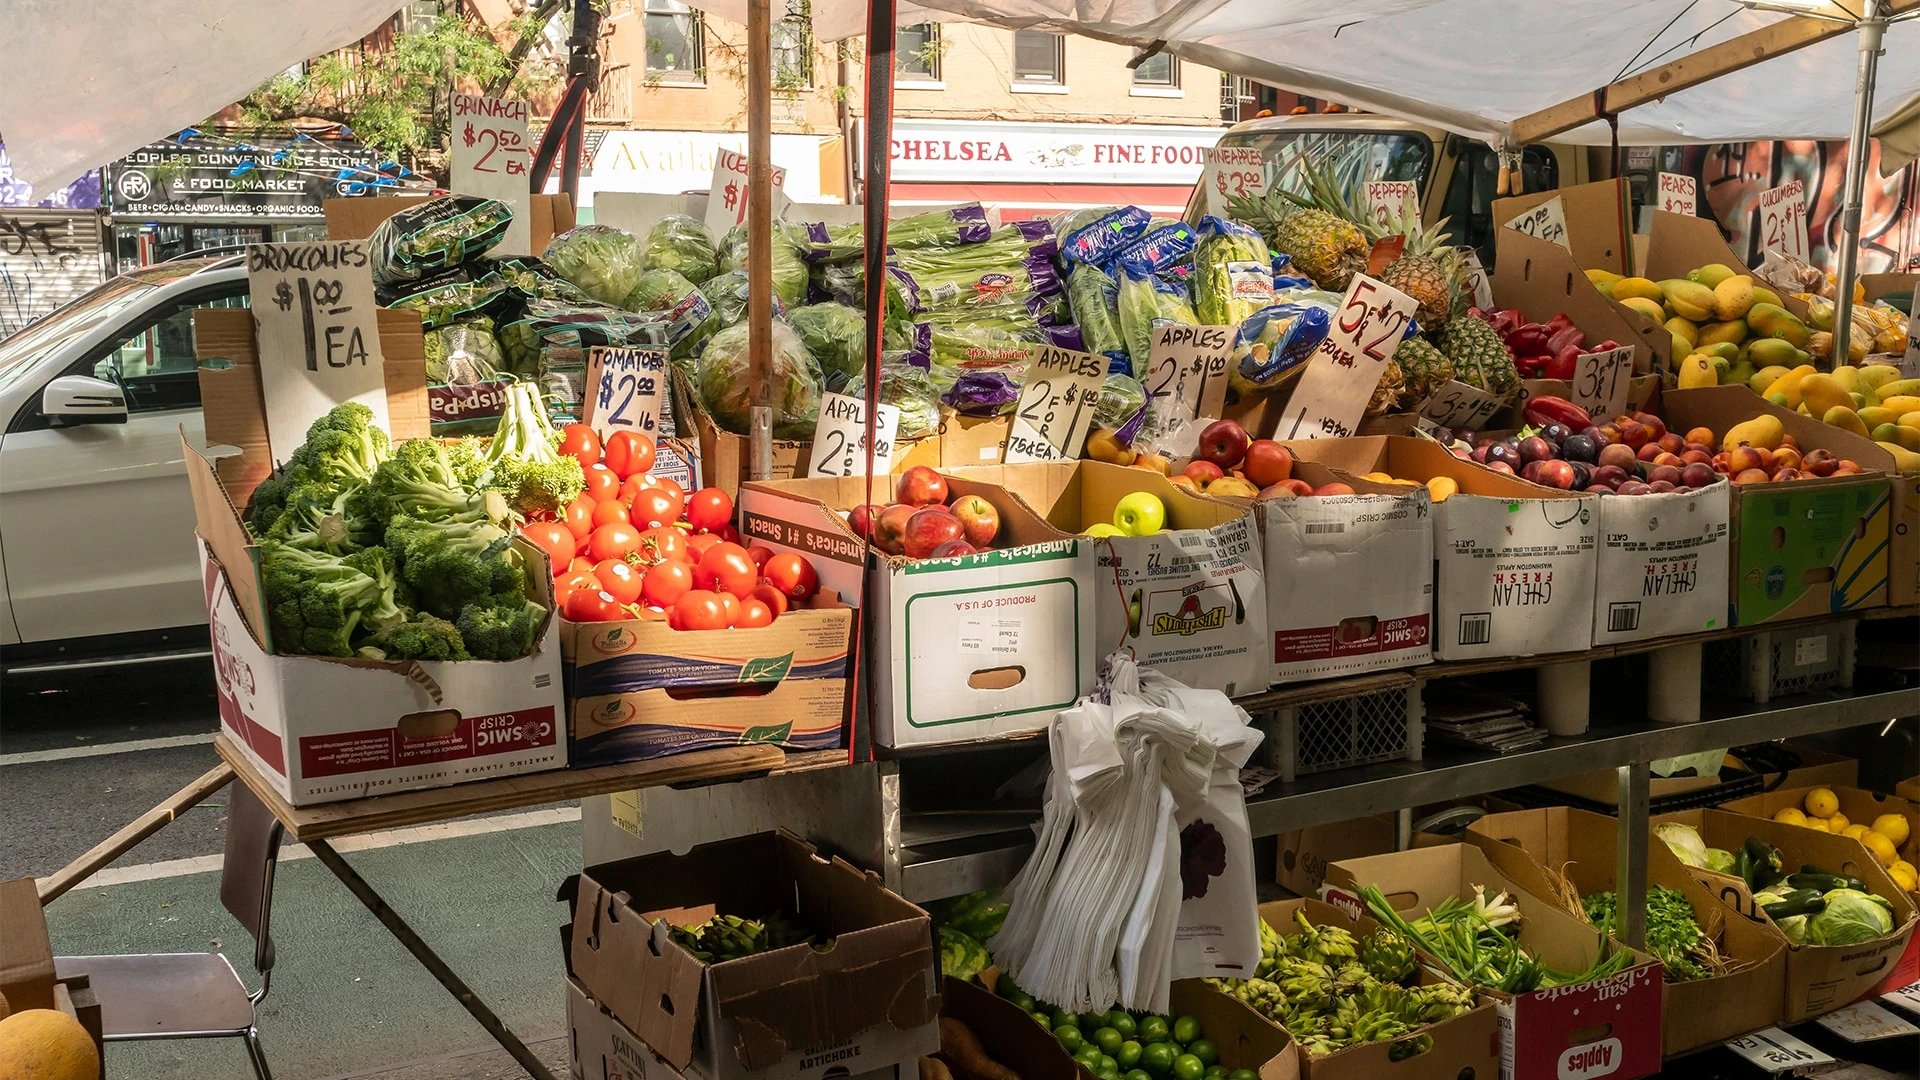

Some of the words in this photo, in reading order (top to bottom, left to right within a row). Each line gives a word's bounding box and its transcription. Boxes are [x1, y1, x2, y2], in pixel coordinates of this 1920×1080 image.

[454, 95, 527, 123] SPINACH
[116, 153, 192, 165] EOPLES
[319, 156, 371, 168] STORE
[1094, 144, 1146, 164] FINE
[1207, 148, 1264, 167] PINEAPPLES
[506, 160, 526, 176] EA
[172, 178, 185, 189] &
[190, 178, 236, 190] FOOD
[241, 179, 307, 192] MARKET
[1661, 174, 1697, 197] PEARS
[1762, 180, 1803, 208] CUCUMBERS
[127, 203, 150, 212] BEER
[152, 203, 180, 213] CIGAR
[184, 204, 214, 213] CANDY
[296, 205, 320, 214] FOOD
[1767, 213, 1780, 247] 2
[1339, 280, 1377, 334] 5
[325, 326, 369, 368] EA
[1159, 327, 1226, 350] APPLES
[592, 348, 665, 372] TOMATOES
[1037, 347, 1101, 378] APPLES
[1153, 356, 1177, 398] 2
[1579, 358, 1599, 398] 3
[1020, 380, 1052, 421] 2
[1039, 395, 1061, 439] FOR
[1427, 391, 1462, 418] 3
[824, 397, 885, 430] APPLS
[817, 429, 846, 476] 2
[1356, 513, 1380, 523] CRISP
[1381, 510, 1408, 521] COSMIC
[1416, 503, 1428, 519] 64
[748, 518, 782, 541] Snack
[1717, 523, 1727, 532] SIZE
[787, 528, 800, 545] #1
[1580, 536, 1594, 544] SIZE
[806, 533, 865, 563] America's
[1239, 541, 1251, 555] US
[1147, 552, 1161, 568] 72
[1516, 563, 1553, 571] WASHINGTON
[1642, 571, 1697, 597] CHELAN
[995, 595, 1036, 606] PRODUCE
[1492, 582, 1552, 608] CHELAN
[953, 601, 979, 611] U.S.A.
[980, 599, 993, 609] OF
[1386, 619, 1408, 631] CRISP
[1384, 626, 1427, 643] COSMIC
[1164, 647, 1201, 657] WASHINGTON
[1213, 647, 1247, 658] DISTRIBUTED
[648, 667, 677, 675] TOMATES
[1333, 662, 1364, 671] INFINITE
[479, 714, 516, 730] CRISP
[476, 721, 552, 748] COSMIC
[649, 736, 678, 745] TOMATES
[441, 744, 468, 753] PRODUCE
[463, 763, 504, 775] FLAVOR
[509, 755, 555, 769] AMAZING
[398, 770, 448, 783] INFINITE
[1597, 981, 1628, 1001] san
[799, 1046, 861, 1071] ARTICHOKE
[1568, 1045, 1613, 1073] Apples
